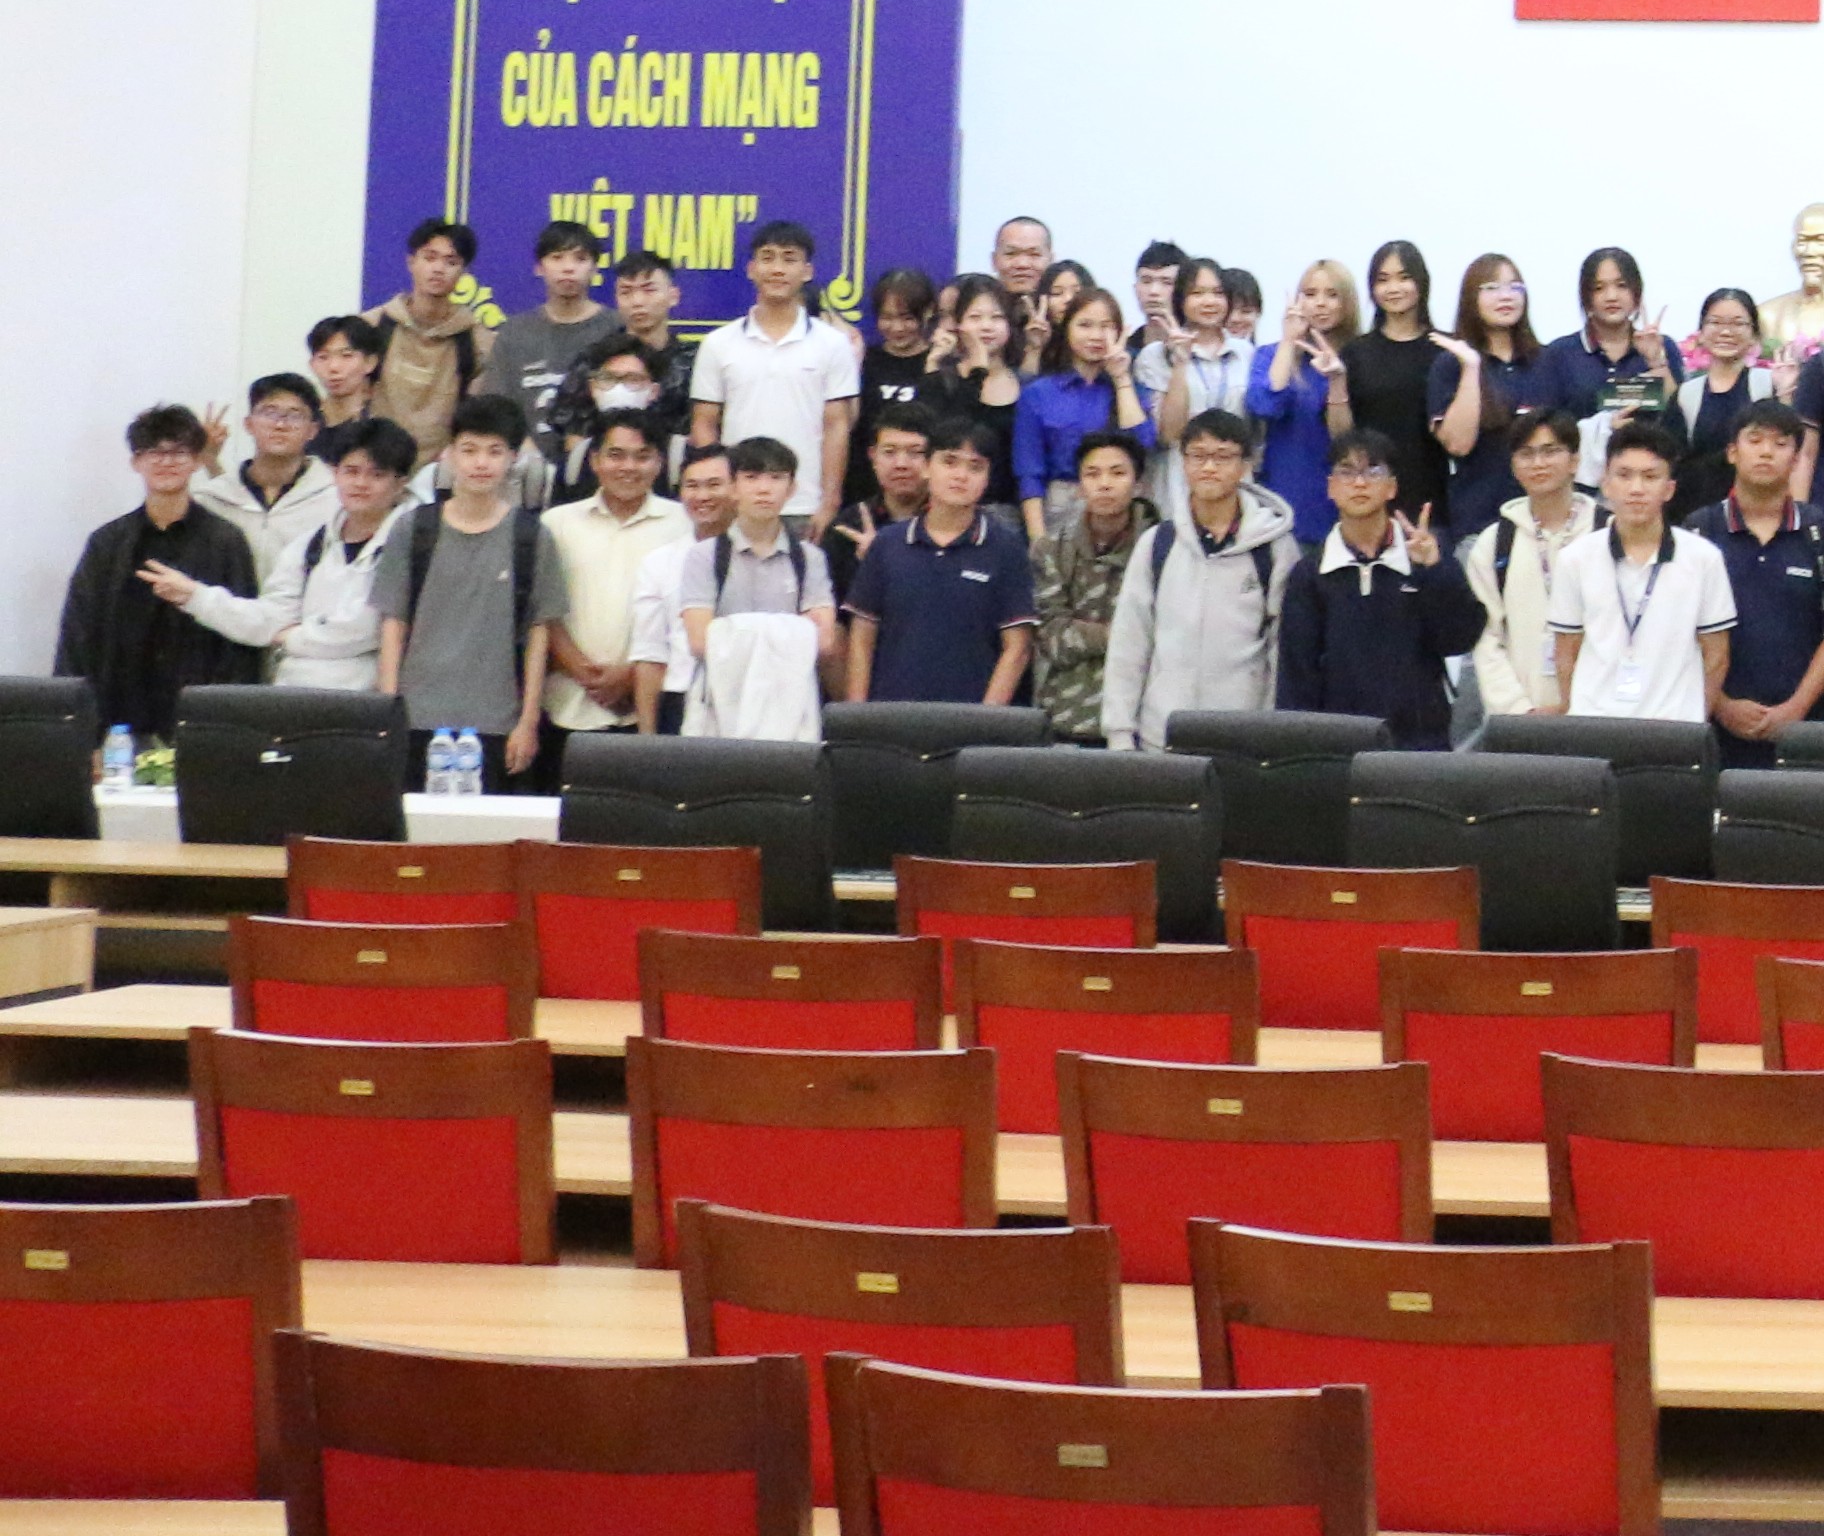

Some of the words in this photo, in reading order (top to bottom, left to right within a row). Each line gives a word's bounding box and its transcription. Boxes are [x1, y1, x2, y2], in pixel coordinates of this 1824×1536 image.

[502, 30, 577, 126] CỦA
[588, 36, 691, 126] CÁCH
[702, 53, 820, 144] MẠNG
[642, 194, 757, 270] NAM”
